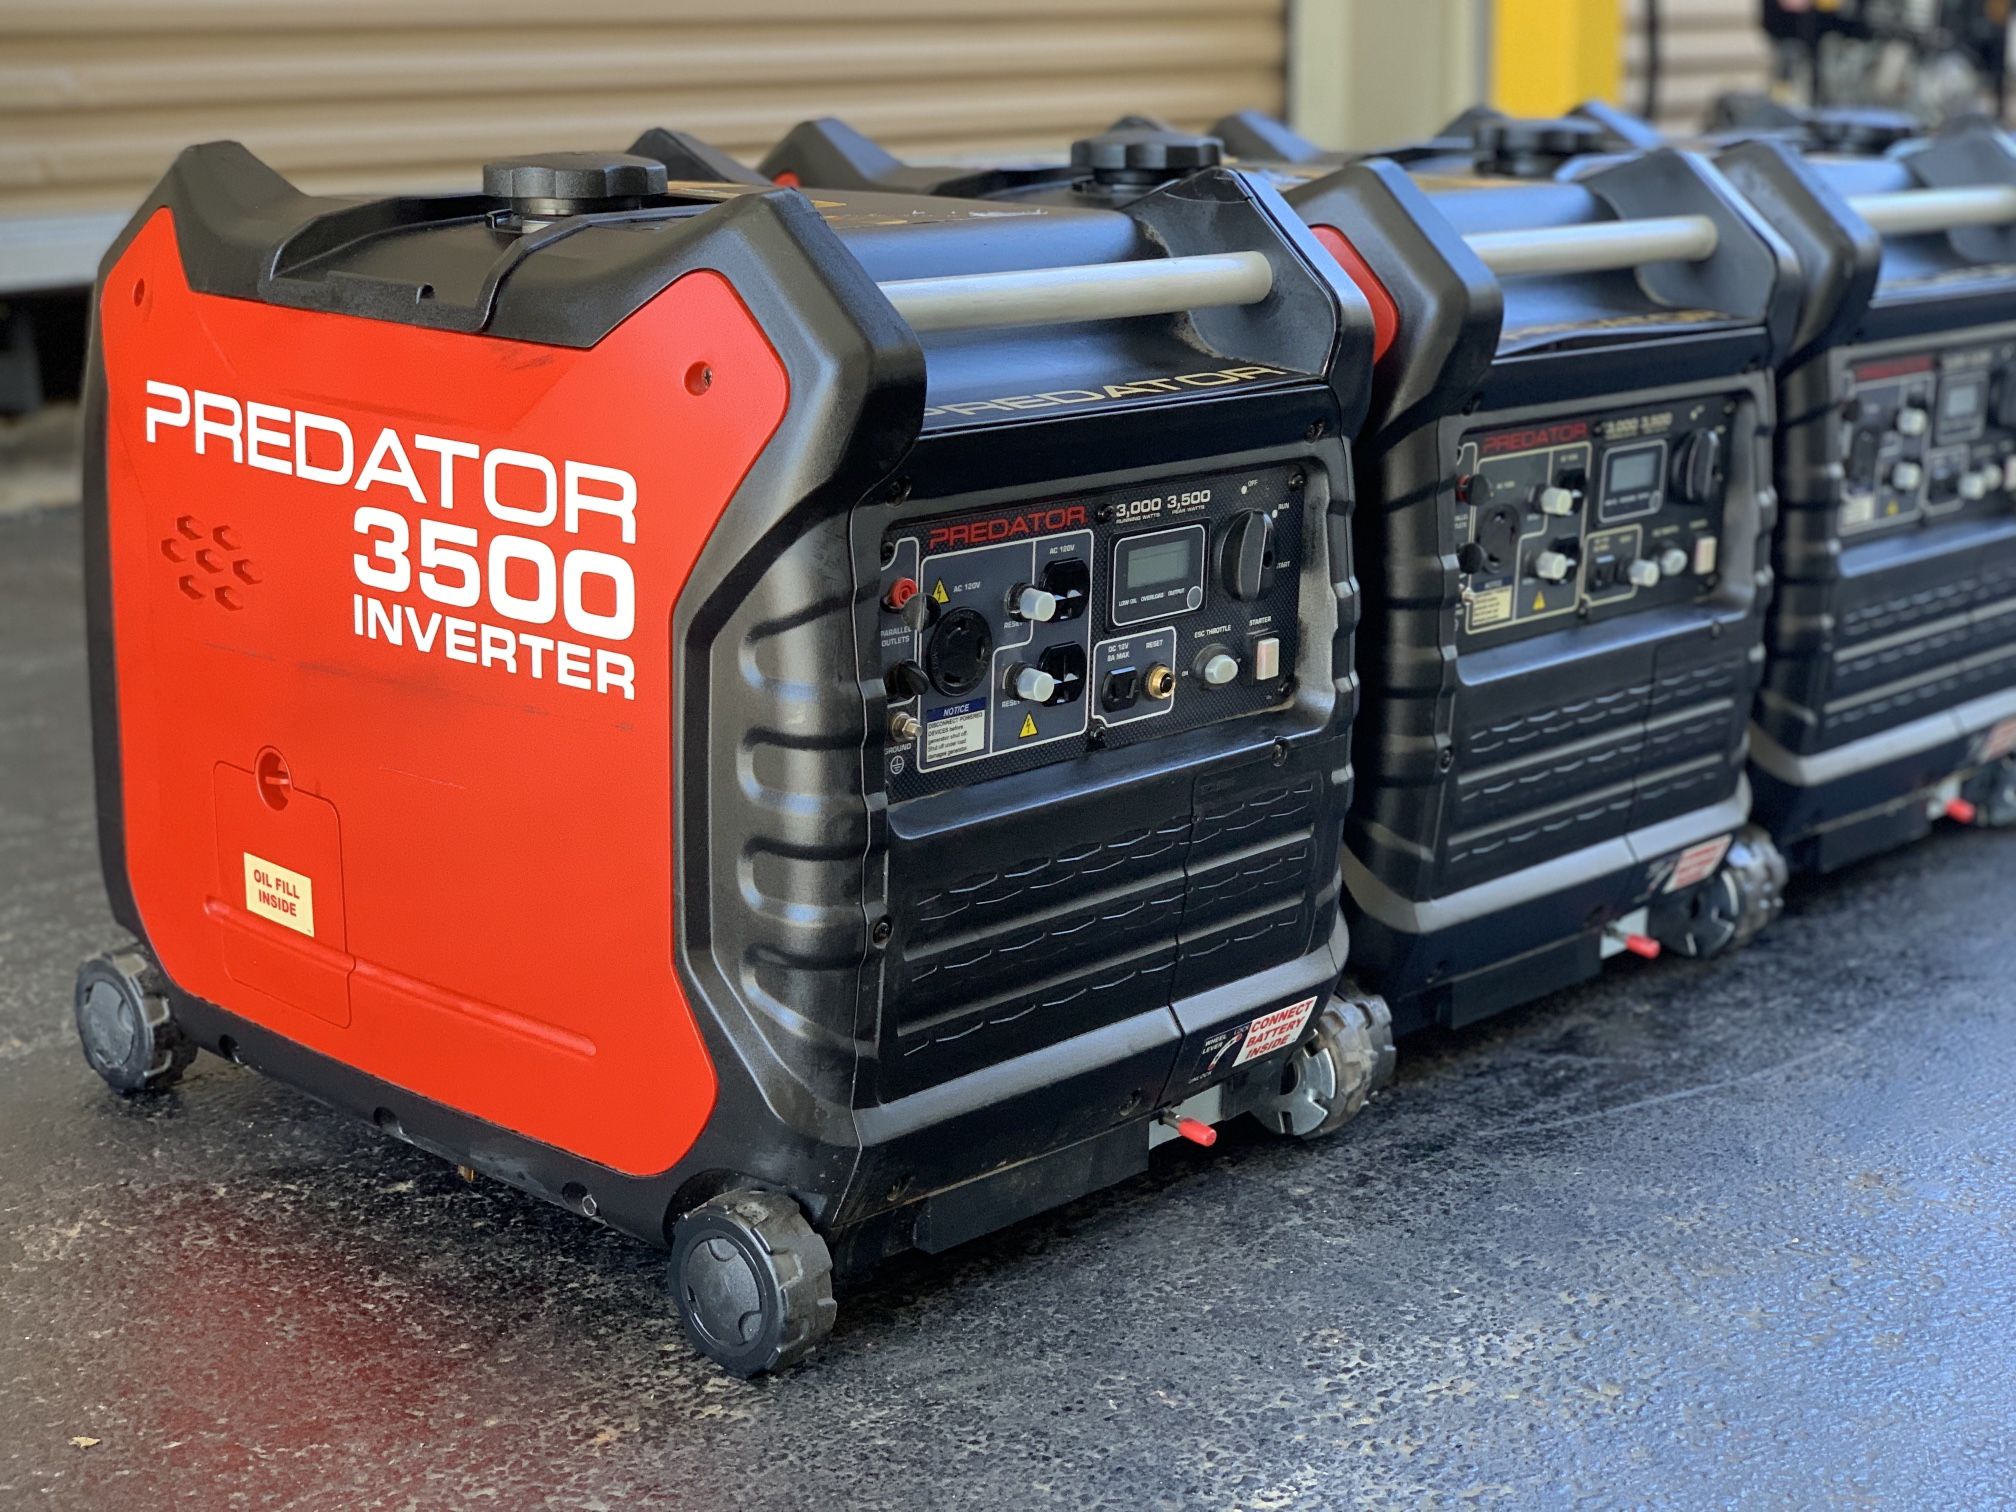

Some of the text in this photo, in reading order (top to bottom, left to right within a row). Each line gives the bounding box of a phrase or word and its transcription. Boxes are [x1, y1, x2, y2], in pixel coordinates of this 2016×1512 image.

[1483, 422, 1588, 453] PREDATOR
[146, 379, 637, 544] PREDATOR
[1247, 479, 1258, 487] OFF
[1115, 489, 1211, 518] 3,000 3,500
[1187, 504, 1205, 512] WATTS
[1278, 502, 1290, 510] RUN
[1142, 512, 1161, 520] WATTS
[928, 505, 1088, 550] PREDATOR
[1049, 544, 1075, 554] AC 120V
[1276, 561, 1290, 569] TART
[353, 506, 635, 641] 3500
[953, 581, 981, 593] AC 120V
[1249, 616, 1272, 626] STARTER
[880, 626, 911, 638] PARALLEL
[1206, 624, 1231, 636] THROTTLE
[353, 593, 635, 700] INVERTER
[881, 636, 910, 647] OUTLETS
[1108, 642, 1129, 653] DC 12V
[1145, 639, 1163, 649] RESET
[1116, 651, 1130, 660] MAX
[943, 703, 970, 717] NOTICE
[253, 868, 300, 900] OIL FILL
[258, 889, 297, 917] INSIDE
[1251, 1000, 1314, 1033] CONNECT
[1246, 1016, 1306, 1048] BATTERY
[1205, 1034, 1227, 1047] WHEEL
[1201, 1041, 1224, 1055] LEVER
[1244, 1034, 1291, 1060] INSIDE
